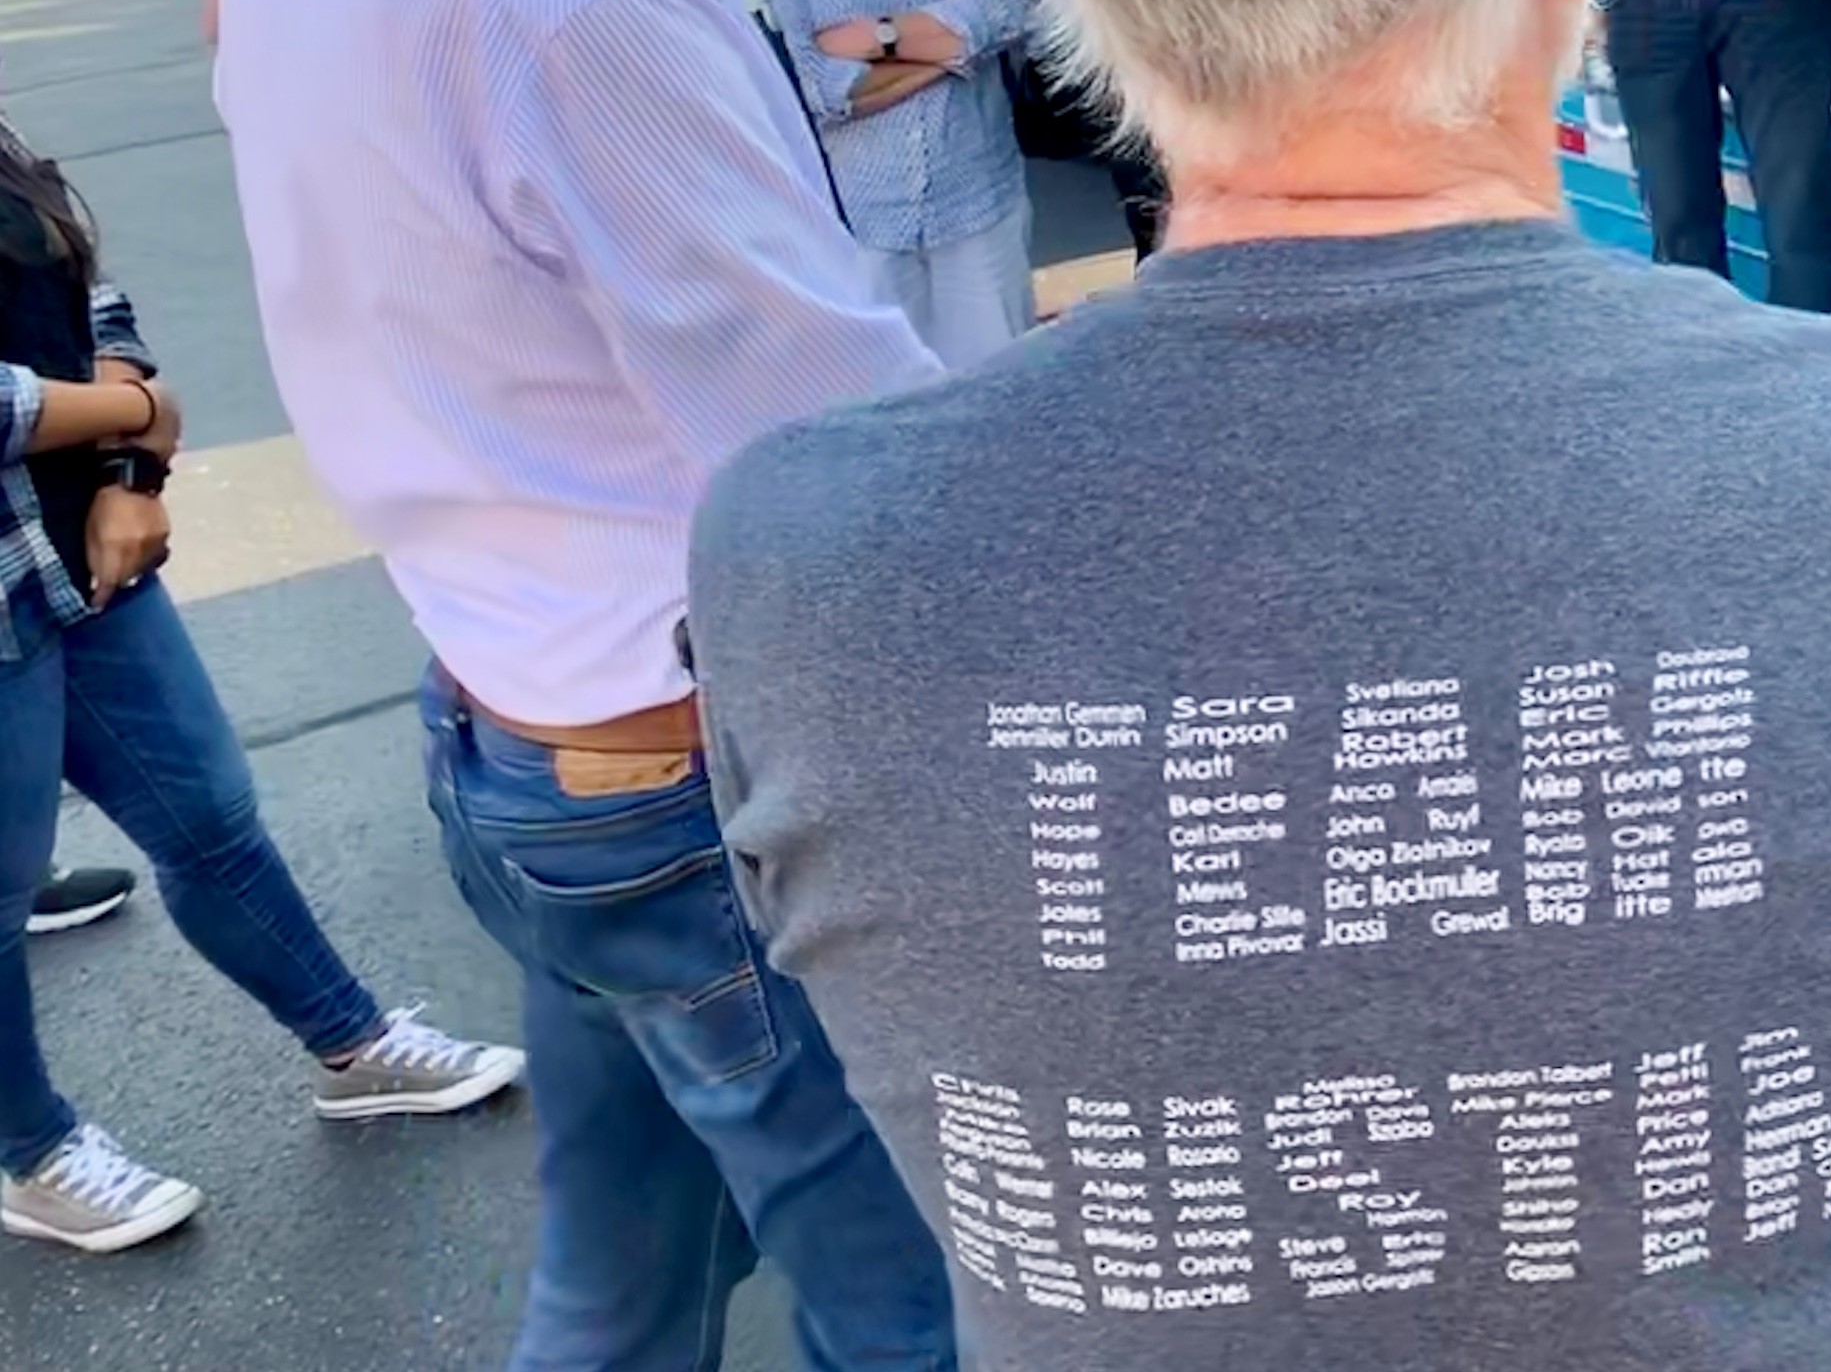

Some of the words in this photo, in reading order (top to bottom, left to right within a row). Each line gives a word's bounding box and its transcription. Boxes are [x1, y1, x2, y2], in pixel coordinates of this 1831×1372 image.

[1524, 657, 1617, 684] Josh
[1345, 677, 1461, 703] Svetlana
[1519, 681, 1615, 709] Susan
[1171, 695, 1295, 719] Sara
[1519, 703, 1611, 727] Eric
[1165, 722, 1289, 751] Simpson
[1342, 723, 1469, 753] Robert
[1522, 724, 1627, 752] Mark
[1163, 753, 1234, 782] Matt
[1332, 743, 1469, 771] Hawkins
[1522, 743, 1634, 772] Marc
[1030, 758, 1097, 784] Justin
[1027, 793, 1097, 812] Wolf
[1325, 814, 1387, 839] John
[1036, 878, 1104, 896] Scott
[1323, 875, 1368, 912] Eric
[1318, 911, 1388, 947] Jassi
[1041, 952, 1105, 970] Todd
[1633, 1041, 1709, 1074] Jeff
[1447, 1070, 1538, 1091] Brandon
[1747, 1065, 1815, 1096] Joe
[1636, 1084, 1710, 1110] Mark
[1066, 1119, 1143, 1139] Brian
[1264, 1108, 1354, 1130] Brandon
[1636, 1109, 1710, 1136] Price
[1640, 1129, 1712, 1155] Amy
[1070, 1147, 1147, 1170] Nicole
[1274, 1150, 1344, 1172] Jeff
[1502, 1154, 1574, 1175] Kyle
[1081, 1179, 1148, 1200] Alex
[1644, 1172, 1709, 1200] Dan
[1080, 1203, 1154, 1223] Chris
[1278, 1236, 1346, 1258] Steve
[1642, 1227, 1708, 1256] Ron
[1093, 1255, 1163, 1279] Dave
